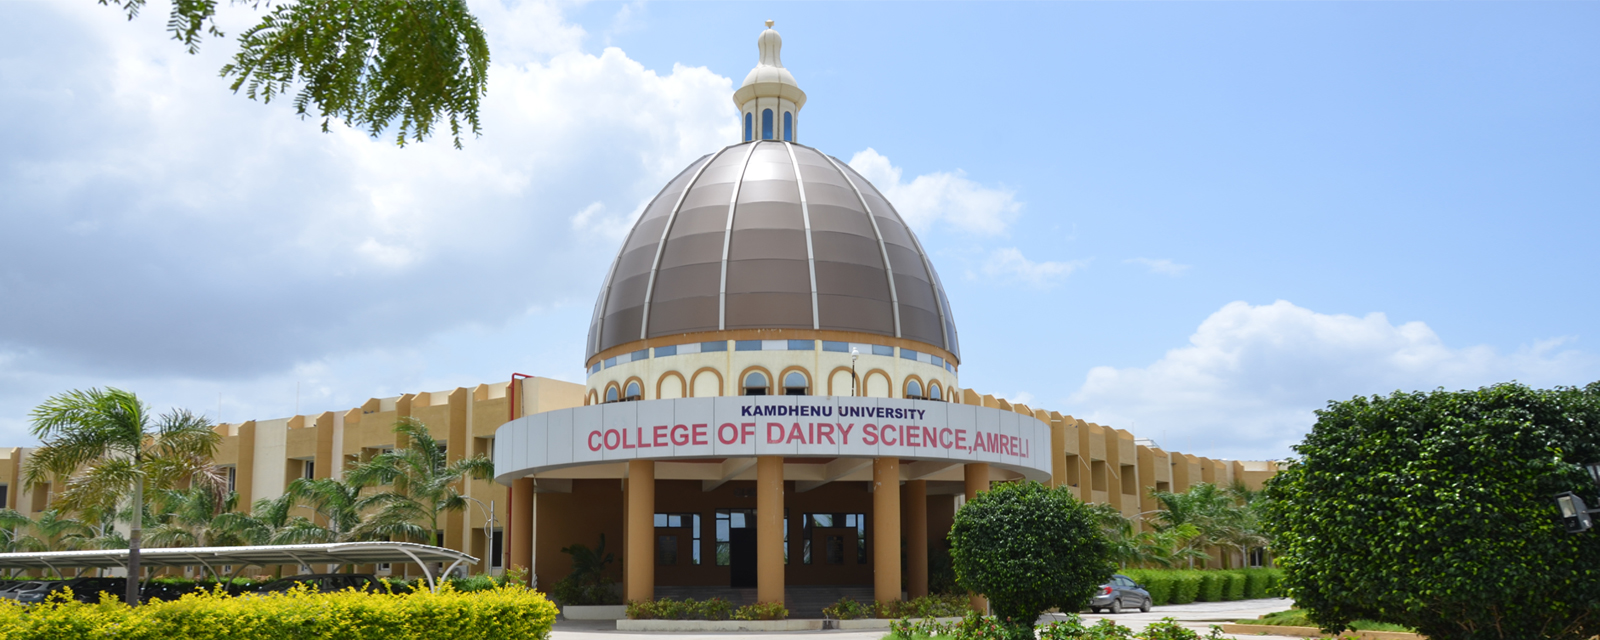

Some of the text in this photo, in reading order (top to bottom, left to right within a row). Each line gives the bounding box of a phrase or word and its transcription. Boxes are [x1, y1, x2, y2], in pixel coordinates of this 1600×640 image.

[741, 405, 926, 421] KAMDHENU UNIVERSITY
[588, 423, 709, 452] COLLEGE
[718, 422, 757, 445] OF
[766, 422, 855, 445] DAIRY
